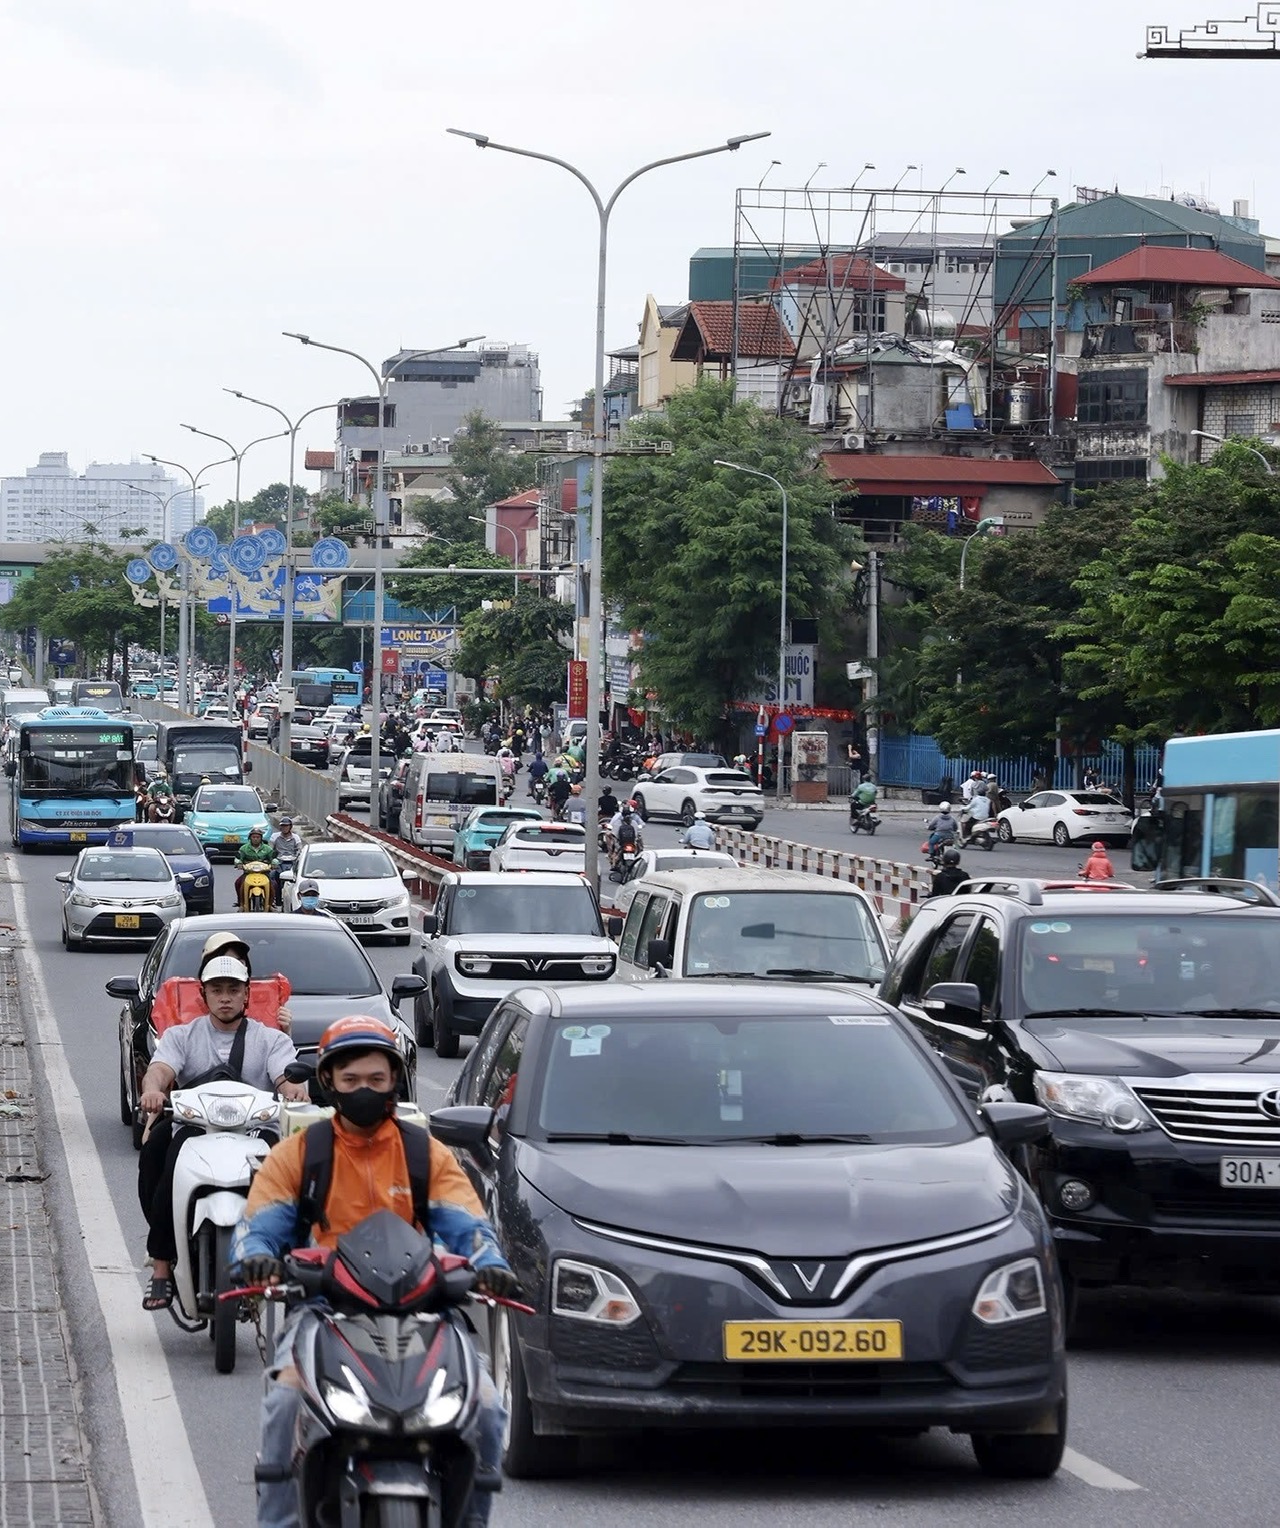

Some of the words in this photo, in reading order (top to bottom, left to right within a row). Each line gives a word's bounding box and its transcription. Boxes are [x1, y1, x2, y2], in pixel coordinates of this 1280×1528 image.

[392, 629, 421, 641] LONG
[1226, 1161, 1280, 1184] 30A-
[740, 1329, 887, 1354] 29K-092.60
